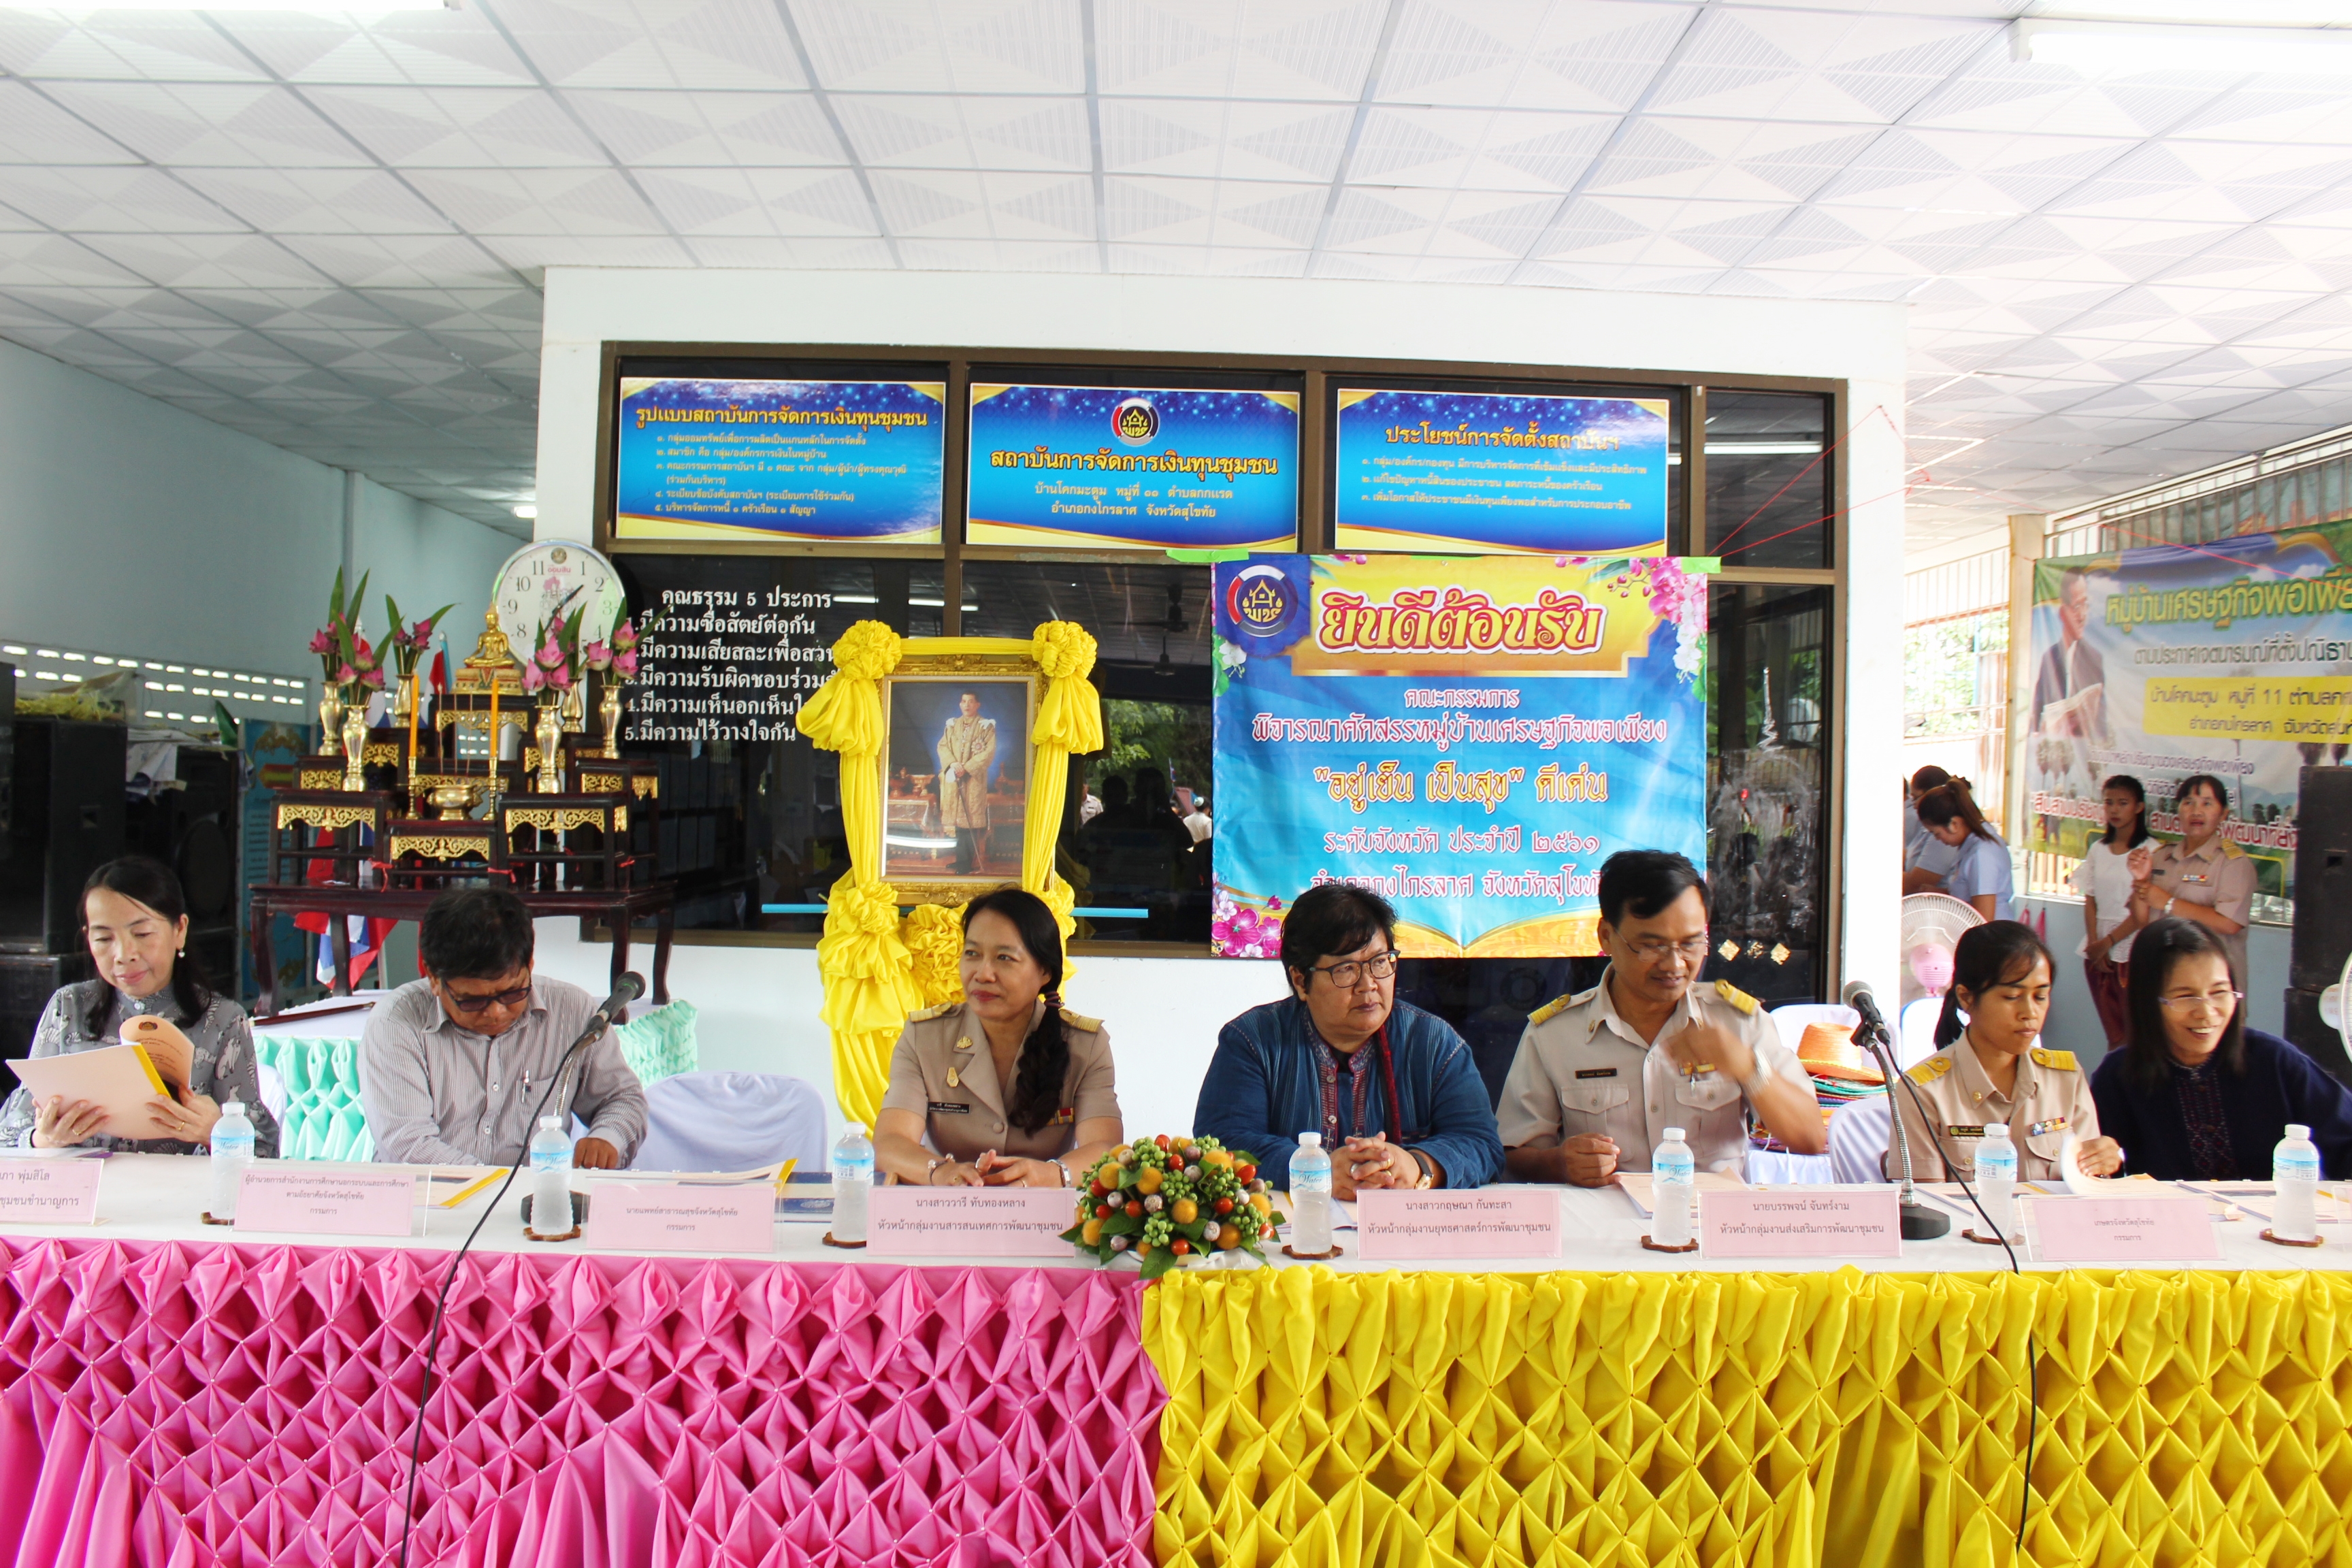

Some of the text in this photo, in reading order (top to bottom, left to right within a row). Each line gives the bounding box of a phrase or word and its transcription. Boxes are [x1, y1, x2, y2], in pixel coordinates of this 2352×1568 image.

[636, 404, 928, 432] รูปแบบสถาบันการจัดการเงินทุนชุมชน
[1385, 420, 1619, 451] ประโยชน์การจัดตั้งสถาบันฯ
[668, 446, 695, 456] สมาชิก
[698, 446, 710, 457] คือ
[757, 461, 764, 471] มี
[799, 464, 814, 472] จาก
[990, 445, 1278, 482] สถาบันการจัดการเงินทุนชุมชน
[666, 475, 727, 485] (ร่วมกันบริหาร)
[1035, 480, 1107, 500] บ้านโคกมะตูม
[1115, 483, 1140, 501] หมู่ที่
[665, 500, 731, 512] บริหารจัดการหนี้
[742, 503, 777, 513] ครัวเรือน
[789, 504, 816, 517] สัญญา
[1051, 500, 1216, 521] อำเภอกงไกรลาศ จังหวัดสุโขทัย
[532, 560, 544, 575] 11
[581, 561, 585, 576] 1
[517, 576, 531, 591] 10
[595, 576, 604, 592] 2
[662, 585, 831, 612] คุณธรรม 5 ประการ
[508, 599, 518, 615] 9
[602, 600, 611, 615] 3
[626, 604, 815, 634] .มีความซื่อสัตย์ต่อกัน
[1319, 587, 1605, 652] ยินดีต้อนรับ
[517, 623, 526, 638] 8
[593, 624, 602, 639] 4
[1404, 688, 1520, 708] คณะกรรมการ
[2151, 685, 2218, 708] บ้านโคกมะตูม
[2228, 683, 2255, 709] หมู่ที่
[2263, 689, 2281, 704] 11
[625, 717, 796, 741] 5.มีความไว้วางใจกัน
[1252, 713, 1667, 751] พิจารณาคัดสรรหมู่บ้านเศรษฐกิจพอเพียง
[1535, 762, 1609, 802] ดีเด่น
[1323, 824, 1601, 855] ระดับจังหวัด ประจำปี ๒๕๖๑
[1482, 863, 1602, 905] จังหวัดสุโขทั
[18, 1169, 50, 1184] พุ่มสิโล
[1298, 1172, 1322, 1183] Water
[916, 1197, 1026, 1208] นางสาววารี ทับทองหลาง
[1406, 1198, 1512, 1212] นางสาวกฤษณา กันทะสา
[1753, 1199, 1850, 1211] นายบรรพจน์ จันทร์งาม
[310, 1207, 338, 1215] กรรมการ
[626, 1206, 738, 1218] นายแพทย์สาธารณสุขจังหวัดสุโขทัย
[878, 1219, 1063, 1234] หัวหน้ากลุ่มงานสารสนเทศการพัฒนาชุมชน
[1368, 1221, 1551, 1237] หัวหน้ากลุ่มงานยุทธศาสตร์การพัฒนาชุมชน
[1720, 1222, 1884, 1237] หัวหน้ากลุ่มงานส่งเสริมการพัฒนาชุมชน
